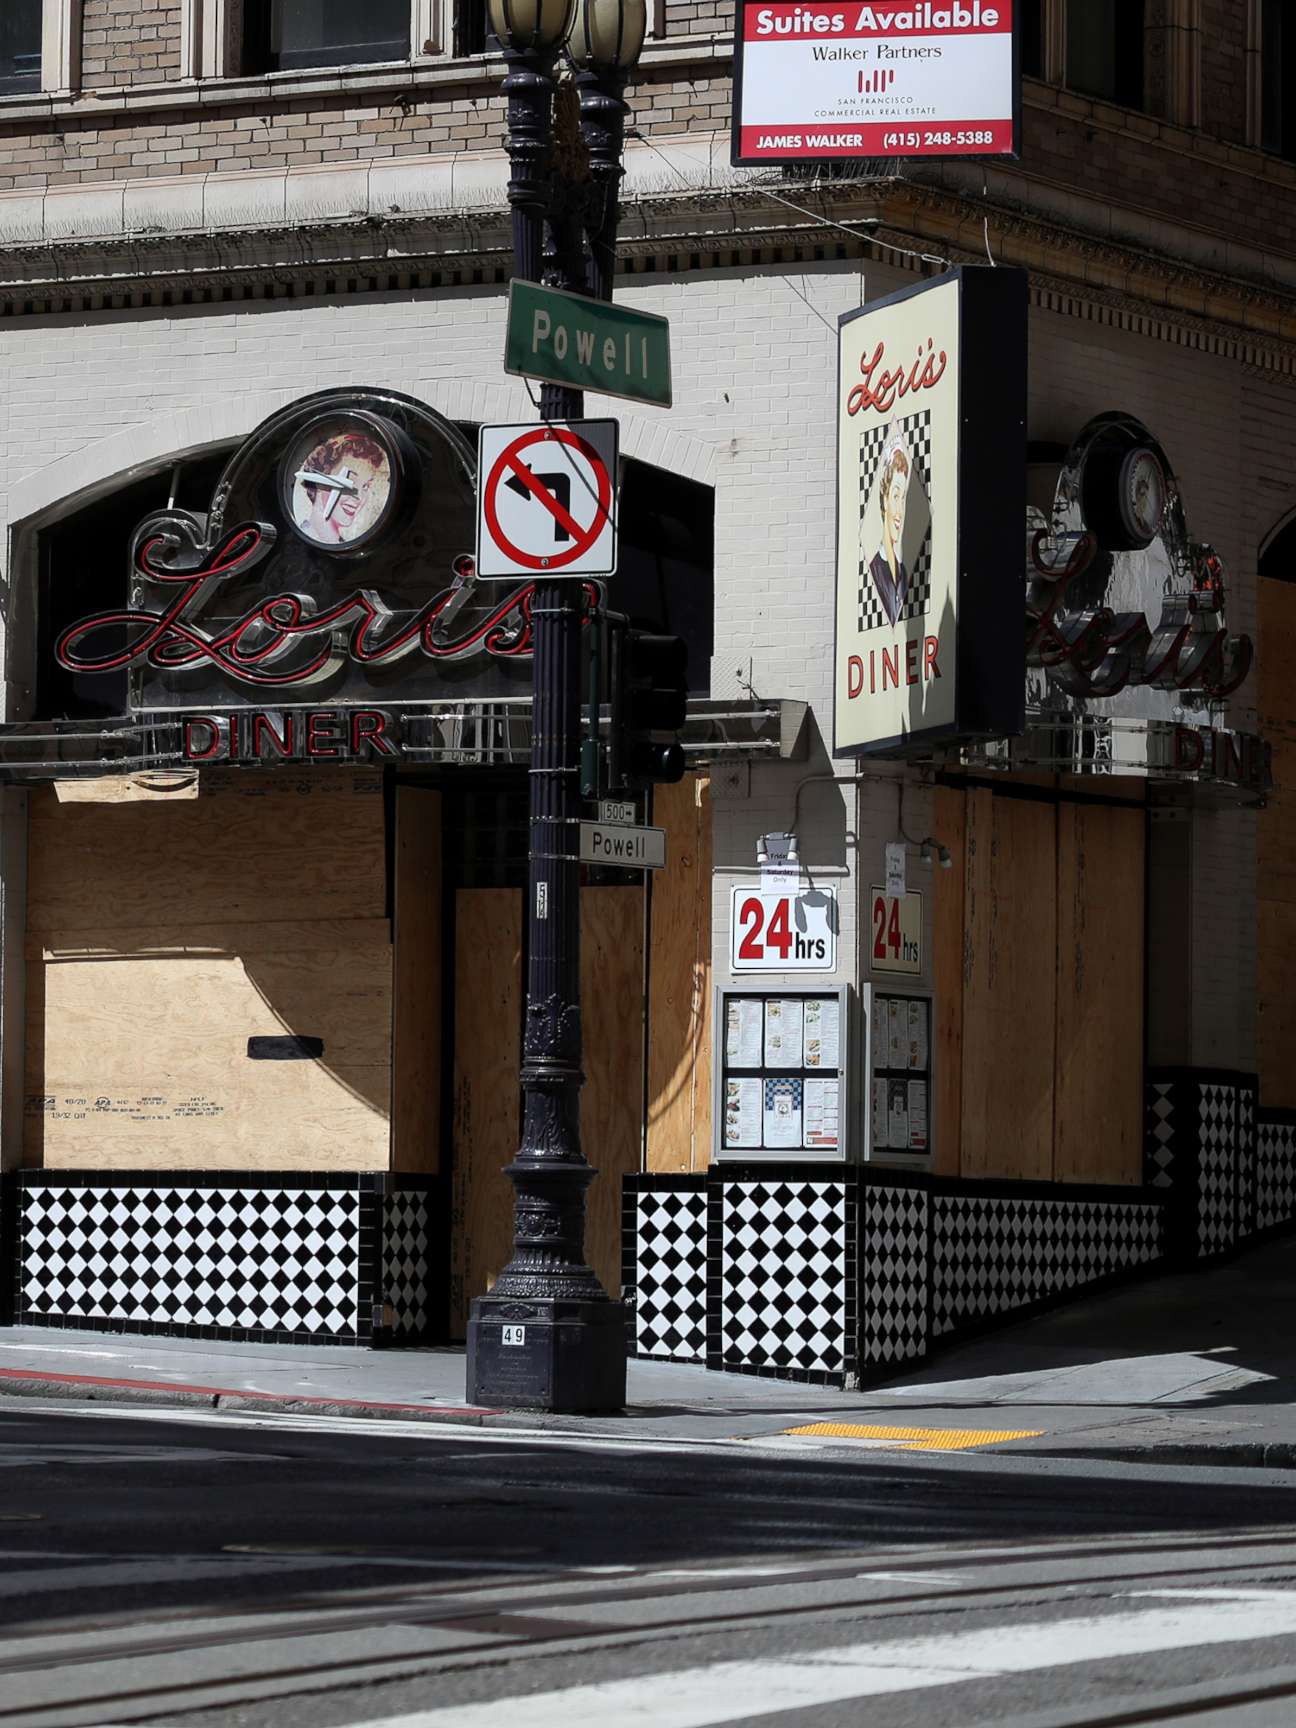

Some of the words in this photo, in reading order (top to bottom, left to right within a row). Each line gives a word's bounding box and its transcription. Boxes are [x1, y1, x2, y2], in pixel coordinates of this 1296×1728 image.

[756, 8, 845, 35] Suites
[855, 0, 1000, 31] Available
[812, 46, 869, 61] Walker
[877, 44, 942, 59] Partners
[860, 96, 914, 104] FRANCISCO
[814, 109, 875, 117] COMMERCIAL
[905, 107, 936, 115] ESTATE
[756, 135, 802, 149] JAMES
[805, 134, 863, 148] WALKER
[883, 132, 921, 149] (415)
[924, 131, 993, 146] 248-5388
[532, 309, 648, 379] Powell
[846, 336, 947, 417] Lori's
[847, 634, 943, 700] DINER
[182, 711, 400, 761] DINER
[606, 804, 625, 820] 500
[592, 832, 645, 858] Powell
[504, 1328, 523, 1343] 49
